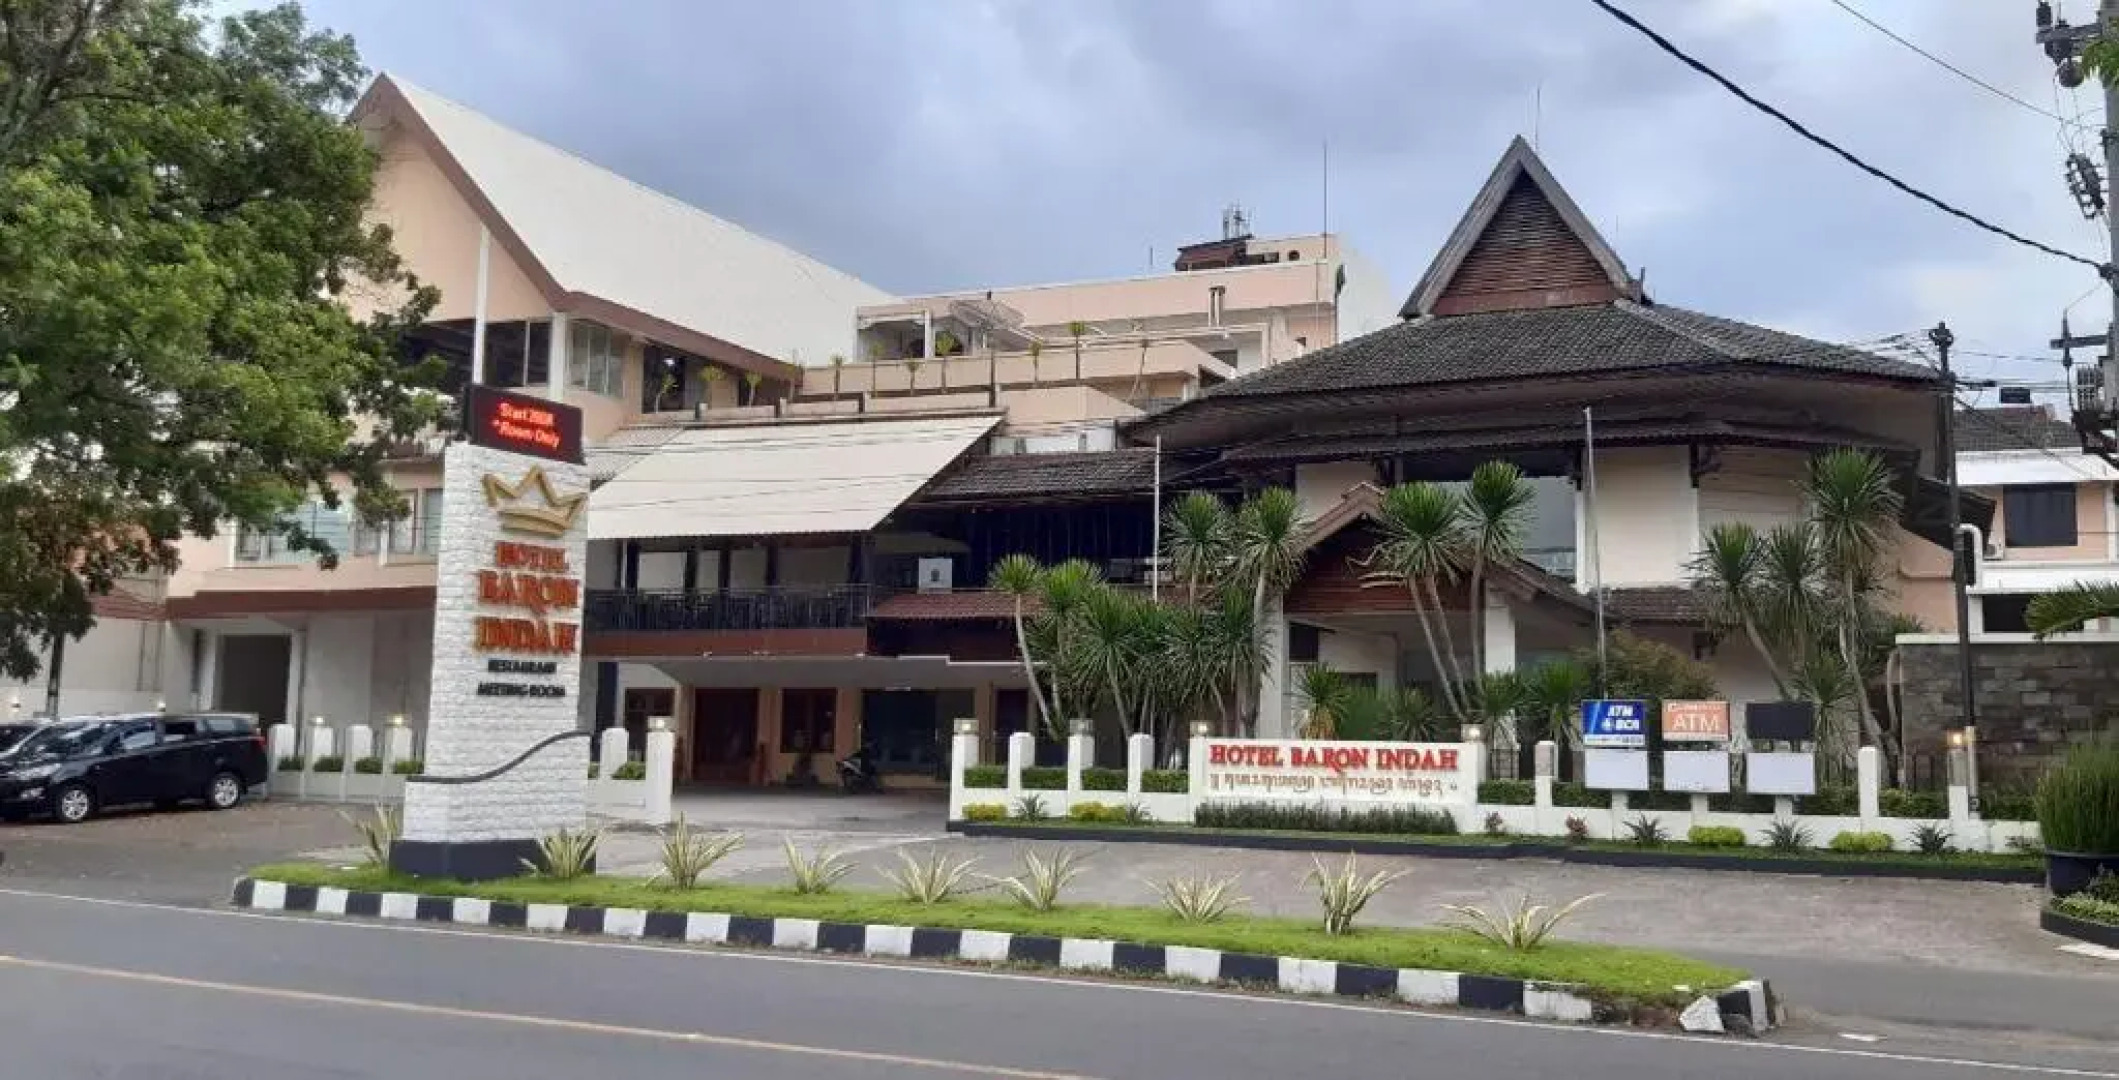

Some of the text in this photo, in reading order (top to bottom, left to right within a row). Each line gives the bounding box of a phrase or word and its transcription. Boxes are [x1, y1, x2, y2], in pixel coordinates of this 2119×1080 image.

[498, 402, 528, 421] Start
[535, 429, 560, 448] Only
[496, 541, 568, 573] HOTEL
[479, 569, 579, 613] BARON
[474, 616, 579, 656] INDAH
[477, 681, 567, 698] MEETING ROOM
[1608, 704, 1634, 717] ATM
[1615, 718, 1641, 731] BCA
[1673, 713, 1721, 731] ATM
[1209, 744, 1460, 773] HOTEL BARON INDAH
